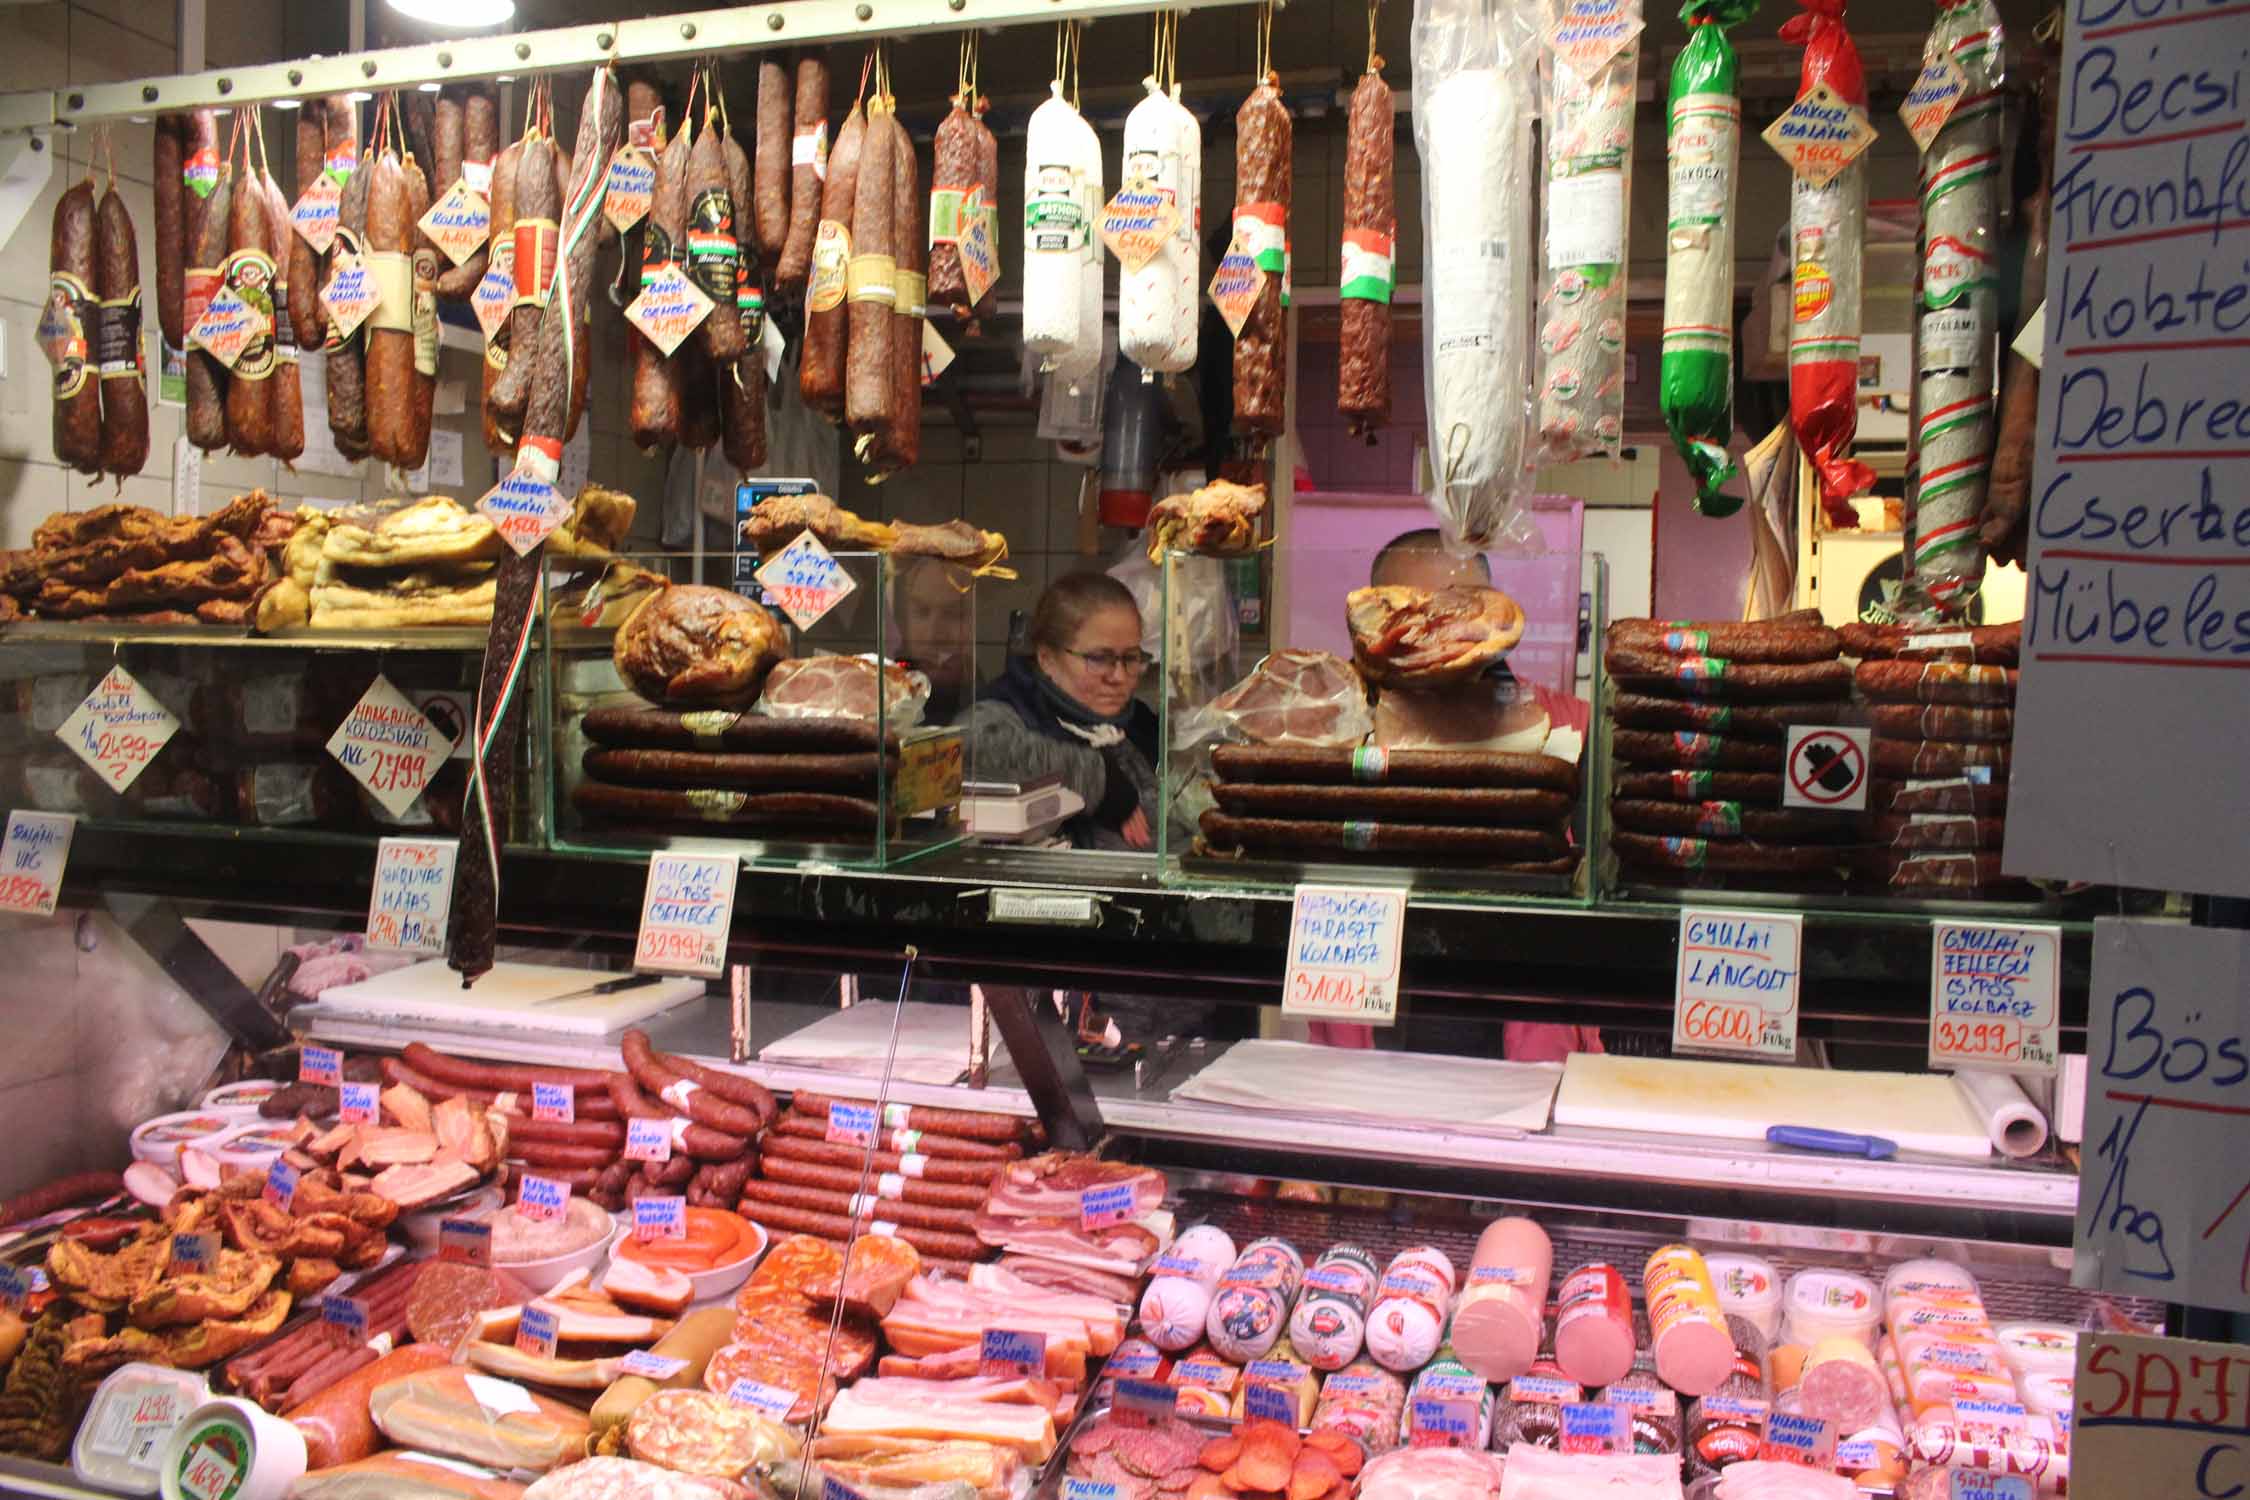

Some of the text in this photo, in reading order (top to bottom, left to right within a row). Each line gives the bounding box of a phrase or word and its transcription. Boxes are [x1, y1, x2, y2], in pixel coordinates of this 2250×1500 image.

[2065, 46, 2246, 141] Bécsi
[1688, 922, 1773, 949] GYULAI
[1943, 929, 2025, 952] GYULAI
[1688, 958, 1797, 991] LÁNGOLT
[1768, 1432, 1815, 1449] SONKA
